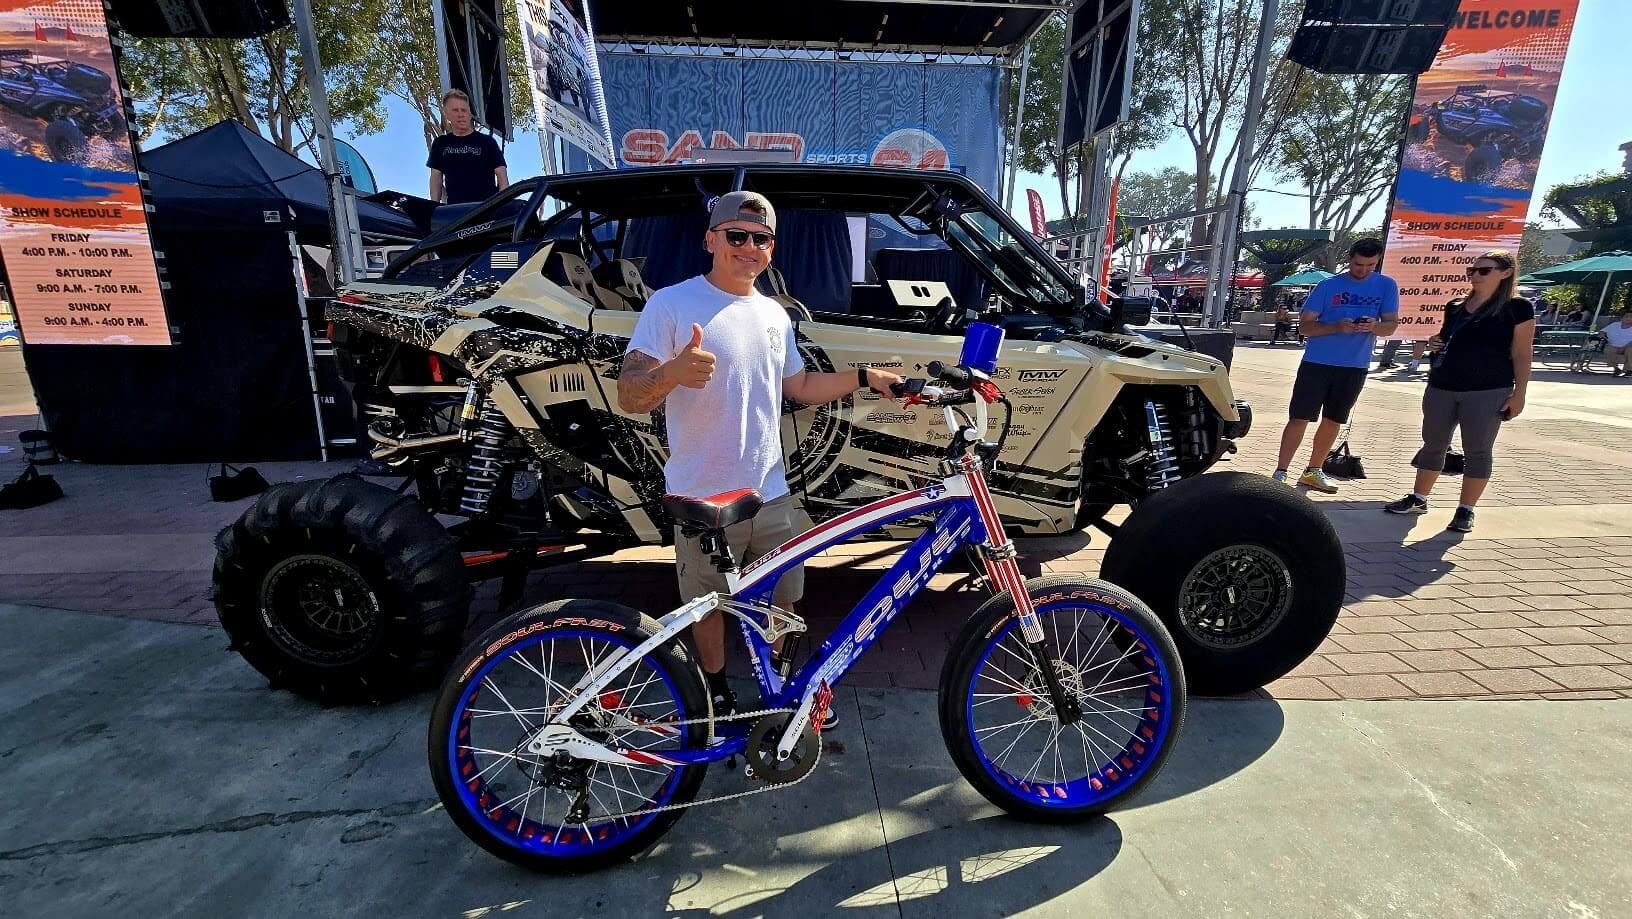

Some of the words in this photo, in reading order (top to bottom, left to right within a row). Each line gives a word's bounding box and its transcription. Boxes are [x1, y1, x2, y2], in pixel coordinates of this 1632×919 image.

[1455, 9, 1561, 29] WELCOME
[806, 153, 867, 164] SPORTS
[12, 207, 49, 218] SHOW
[54, 208, 122, 218] SCHEDULE
[1407, 221, 1441, 231] SHOW
[1444, 221, 1505, 231] SCHEDULE
[51, 233, 91, 243] FRIDAY
[22, 247, 45, 257] 4:00
[49, 248, 70, 257] P.M.
[79, 248, 109, 258] 10:00
[111, 248, 133, 258] P.M.
[1431, 243, 1468, 252] FRIDAY
[1400, 256, 1420, 265] 4:00
[1423, 256, 1442, 265] P.M.
[55, 269, 113, 278] SATURDAY
[36, 283, 60, 293] 9:00
[63, 284, 87, 294] A.M.
[95, 284, 118, 294] 7:00
[121, 285, 142, 294] P.M.
[1400, 287, 1420, 296] 9:00
[1421, 287, 1442, 296] A.M.
[68, 302, 111, 312] SUNDAY
[1420, 304, 1446, 312] SUND
[44, 316, 68, 326] 9:00
[70, 317, 94, 326] A.M.
[101, 317, 125, 327] 4:00
[128, 317, 149, 327] P.M.
[1398, 316, 1413, 325] :00
[1415, 316, 1436, 325] A.M.
[1016, 369, 1068, 381] TMW
[909, 525, 971, 597] BIKES
[812, 516, 970, 683] SOUL
[1071, 590, 1132, 611] FAST
[486, 621, 552, 657] SOUL
[552, 617, 627, 632] FAST
